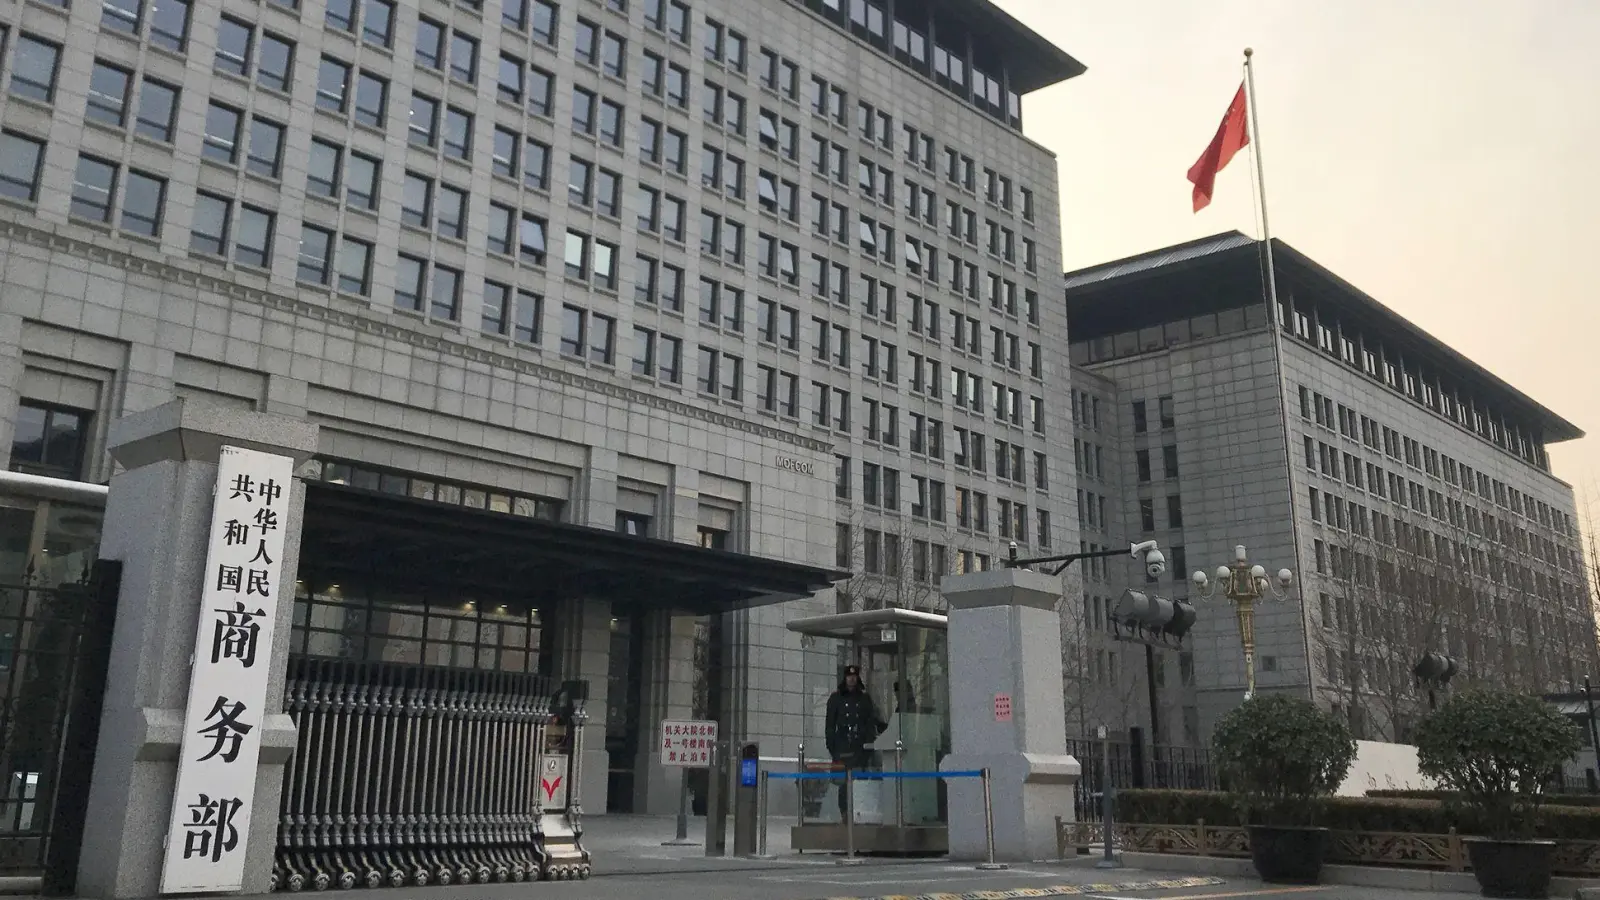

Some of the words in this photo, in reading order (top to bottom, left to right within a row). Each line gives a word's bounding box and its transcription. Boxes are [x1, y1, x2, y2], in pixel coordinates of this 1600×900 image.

[776, 455, 814, 475] MOFCOM
[216, 473, 255, 594] 共和国
[246, 478, 282, 598] 中华人民
[182, 602, 267, 863] 商务部
[664, 725, 715, 736] 机关大院北侧
[664, 738, 714, 749] 及一号楼南侧
[668, 751, 708, 762] 禁止泊车
